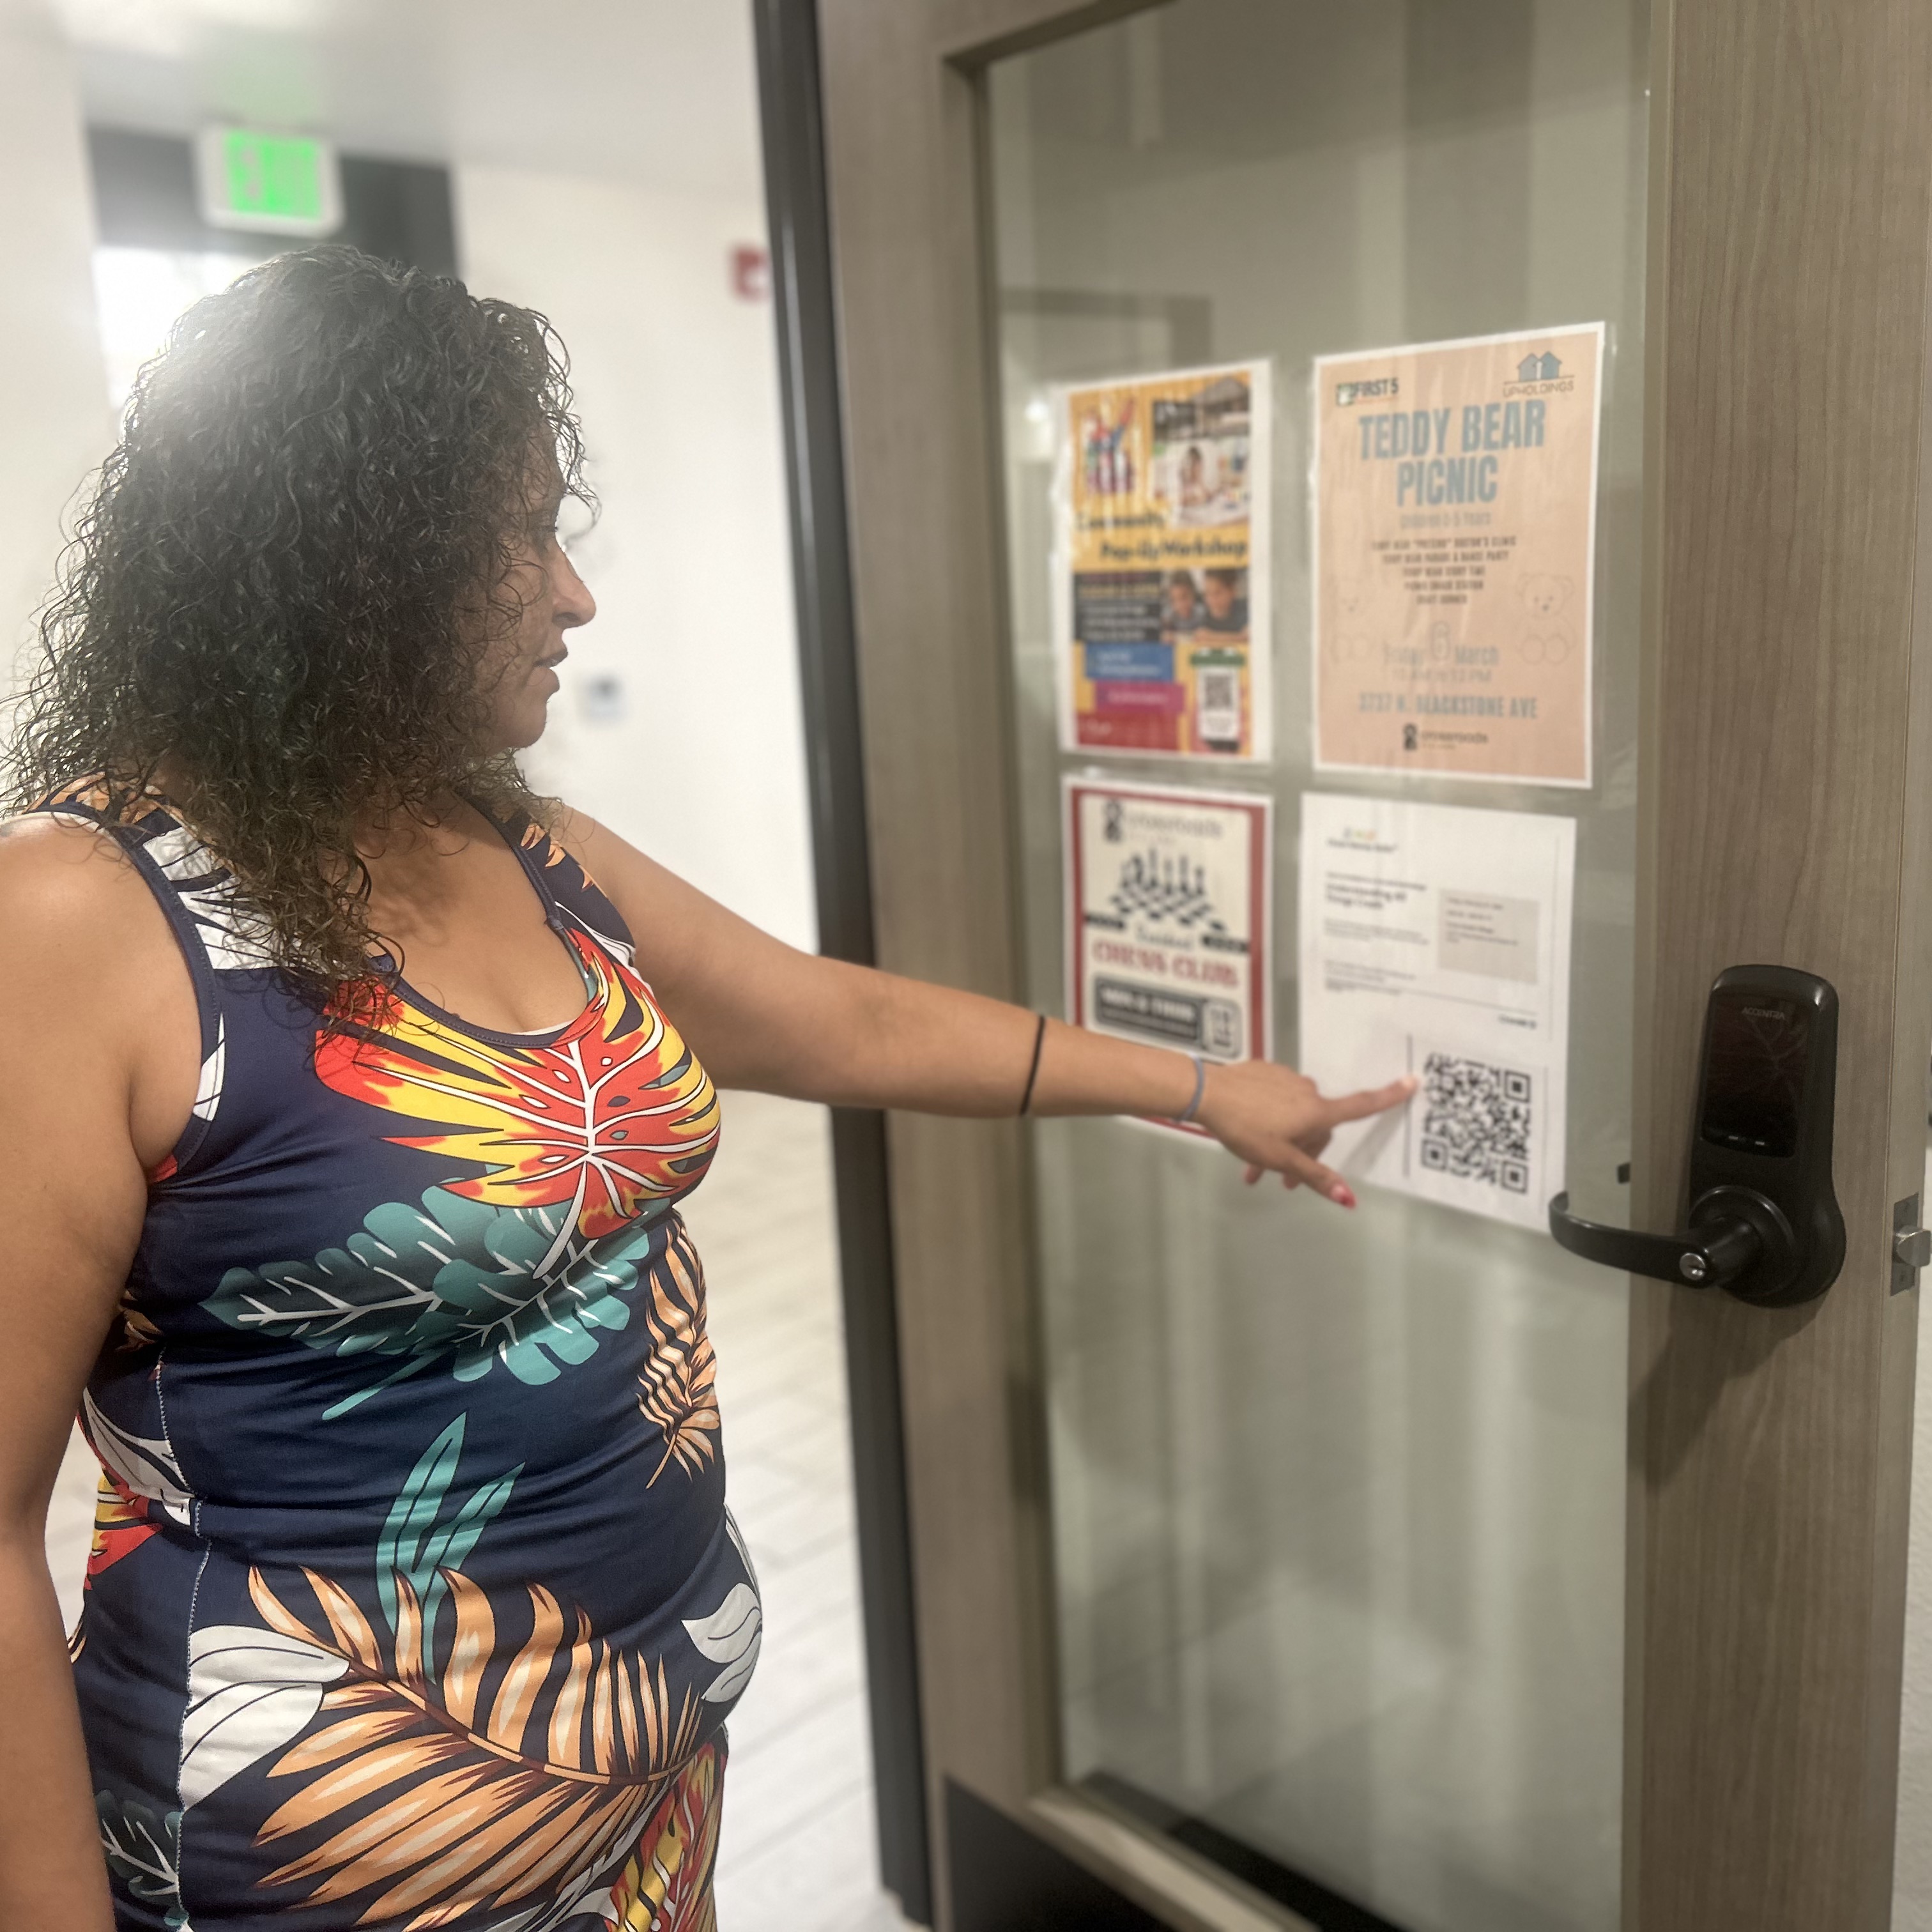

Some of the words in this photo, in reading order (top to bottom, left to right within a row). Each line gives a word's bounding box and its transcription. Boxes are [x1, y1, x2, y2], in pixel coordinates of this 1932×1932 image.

[1353, 378, 1388, 397] FIRST
[1390, 377, 1399, 395] 5
[1503, 381, 1574, 397] UPHOLDINGS
[1358, 407, 1452, 461] TEDDY
[1462, 399, 1547, 453] BEAR
[1397, 455, 1498, 507] PICNIC
[1415, 694, 1505, 718] BLACKSTONE
[1508, 696, 1539, 719] AVE
[1171, 954, 1240, 988] CLUB
